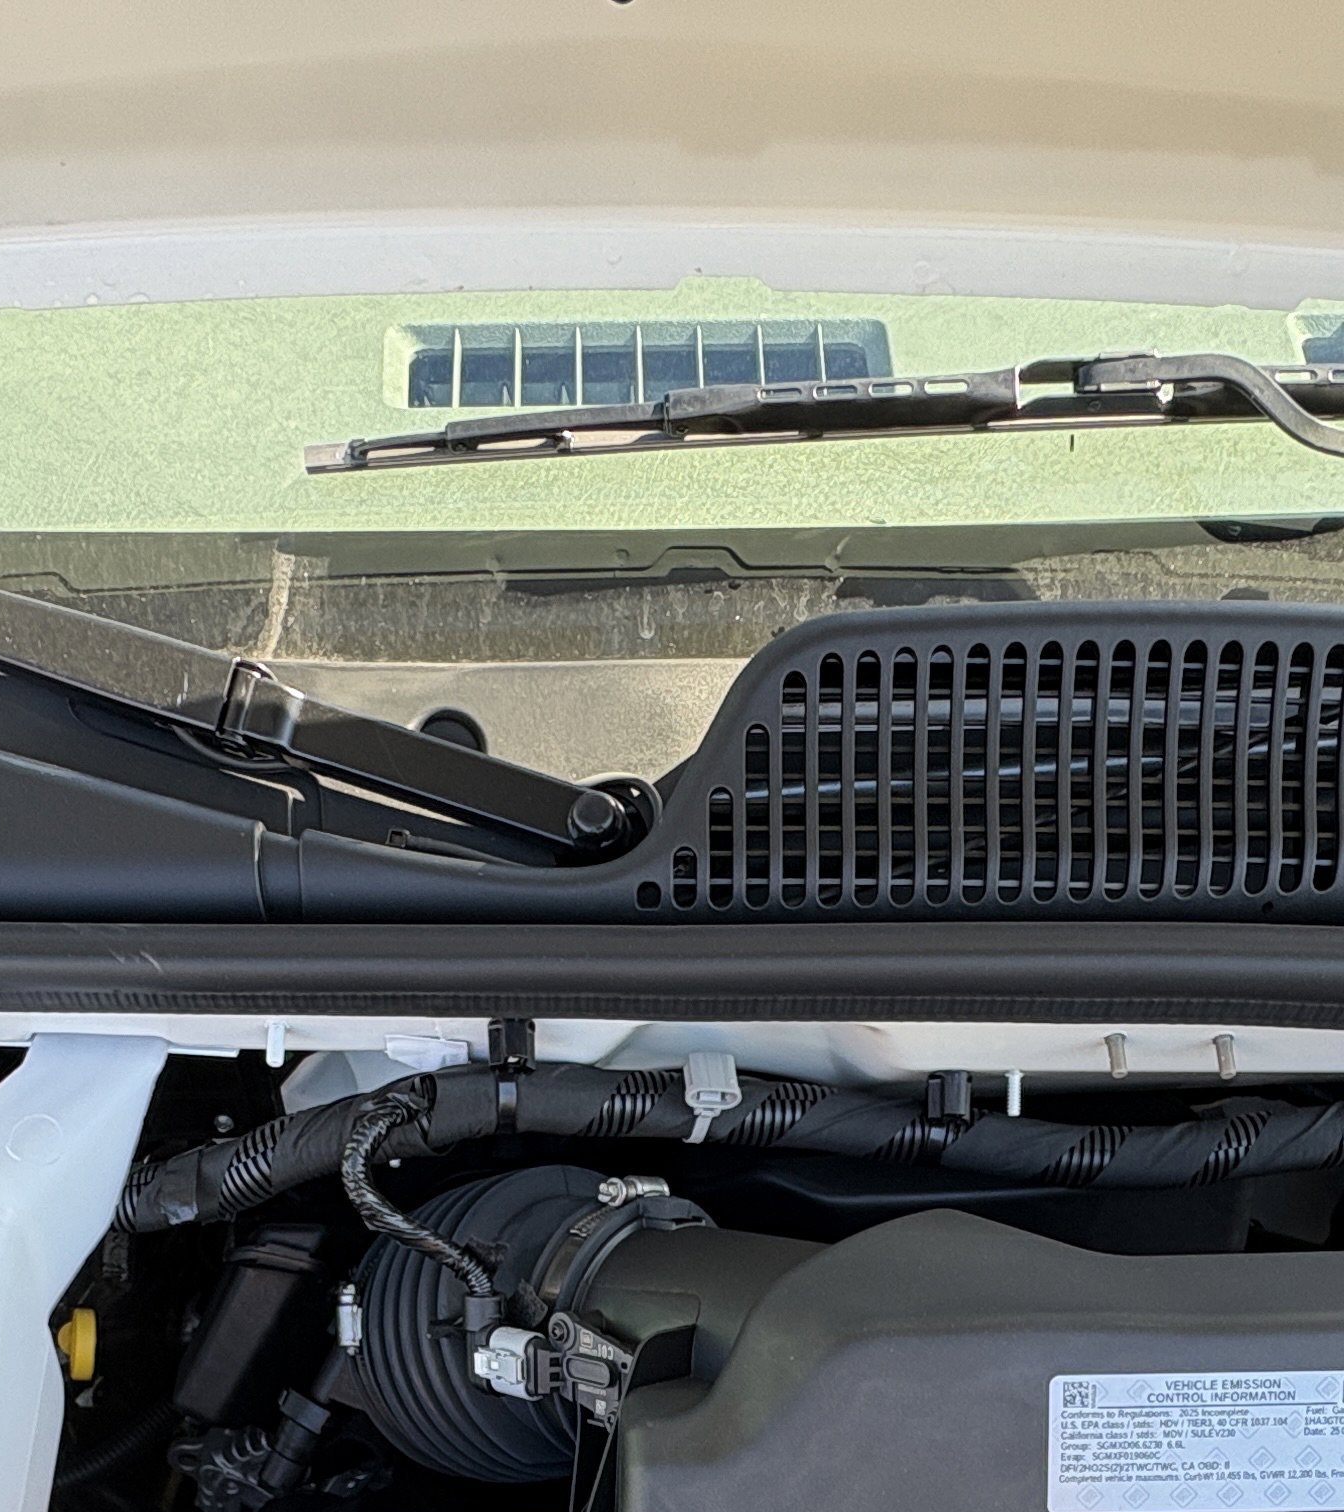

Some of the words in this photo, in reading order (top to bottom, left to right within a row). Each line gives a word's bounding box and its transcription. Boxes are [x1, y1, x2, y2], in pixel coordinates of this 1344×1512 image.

[1165, 1379, 1218, 1391] VEHICLE
[1221, 1378, 1281, 1390] EMISSION
[1146, 1391, 1207, 1403] CONTROL
[1210, 1390, 1296, 1402] INFORMATION
[1060, 1410, 1105, 1419] Conforms
[1201, 1408, 1250, 1418] Incomplete
[1305, 1406, 1328, 1415] Fuel:
[1060, 1421, 1078, 1430] U.S.
[1081, 1420, 1099, 1430] EPA
[1101, 1420, 1125, 1429] class
[1228, 1418, 1248, 1427] CFR
[1060, 1430, 1103, 1440] California
[1105, 1431, 1128, 1440] class
[1162, 1429, 1183, 1438] MDV
[1060, 1441, 1092, 1452] Group:
[1181, 1461, 1195, 1471] CA
